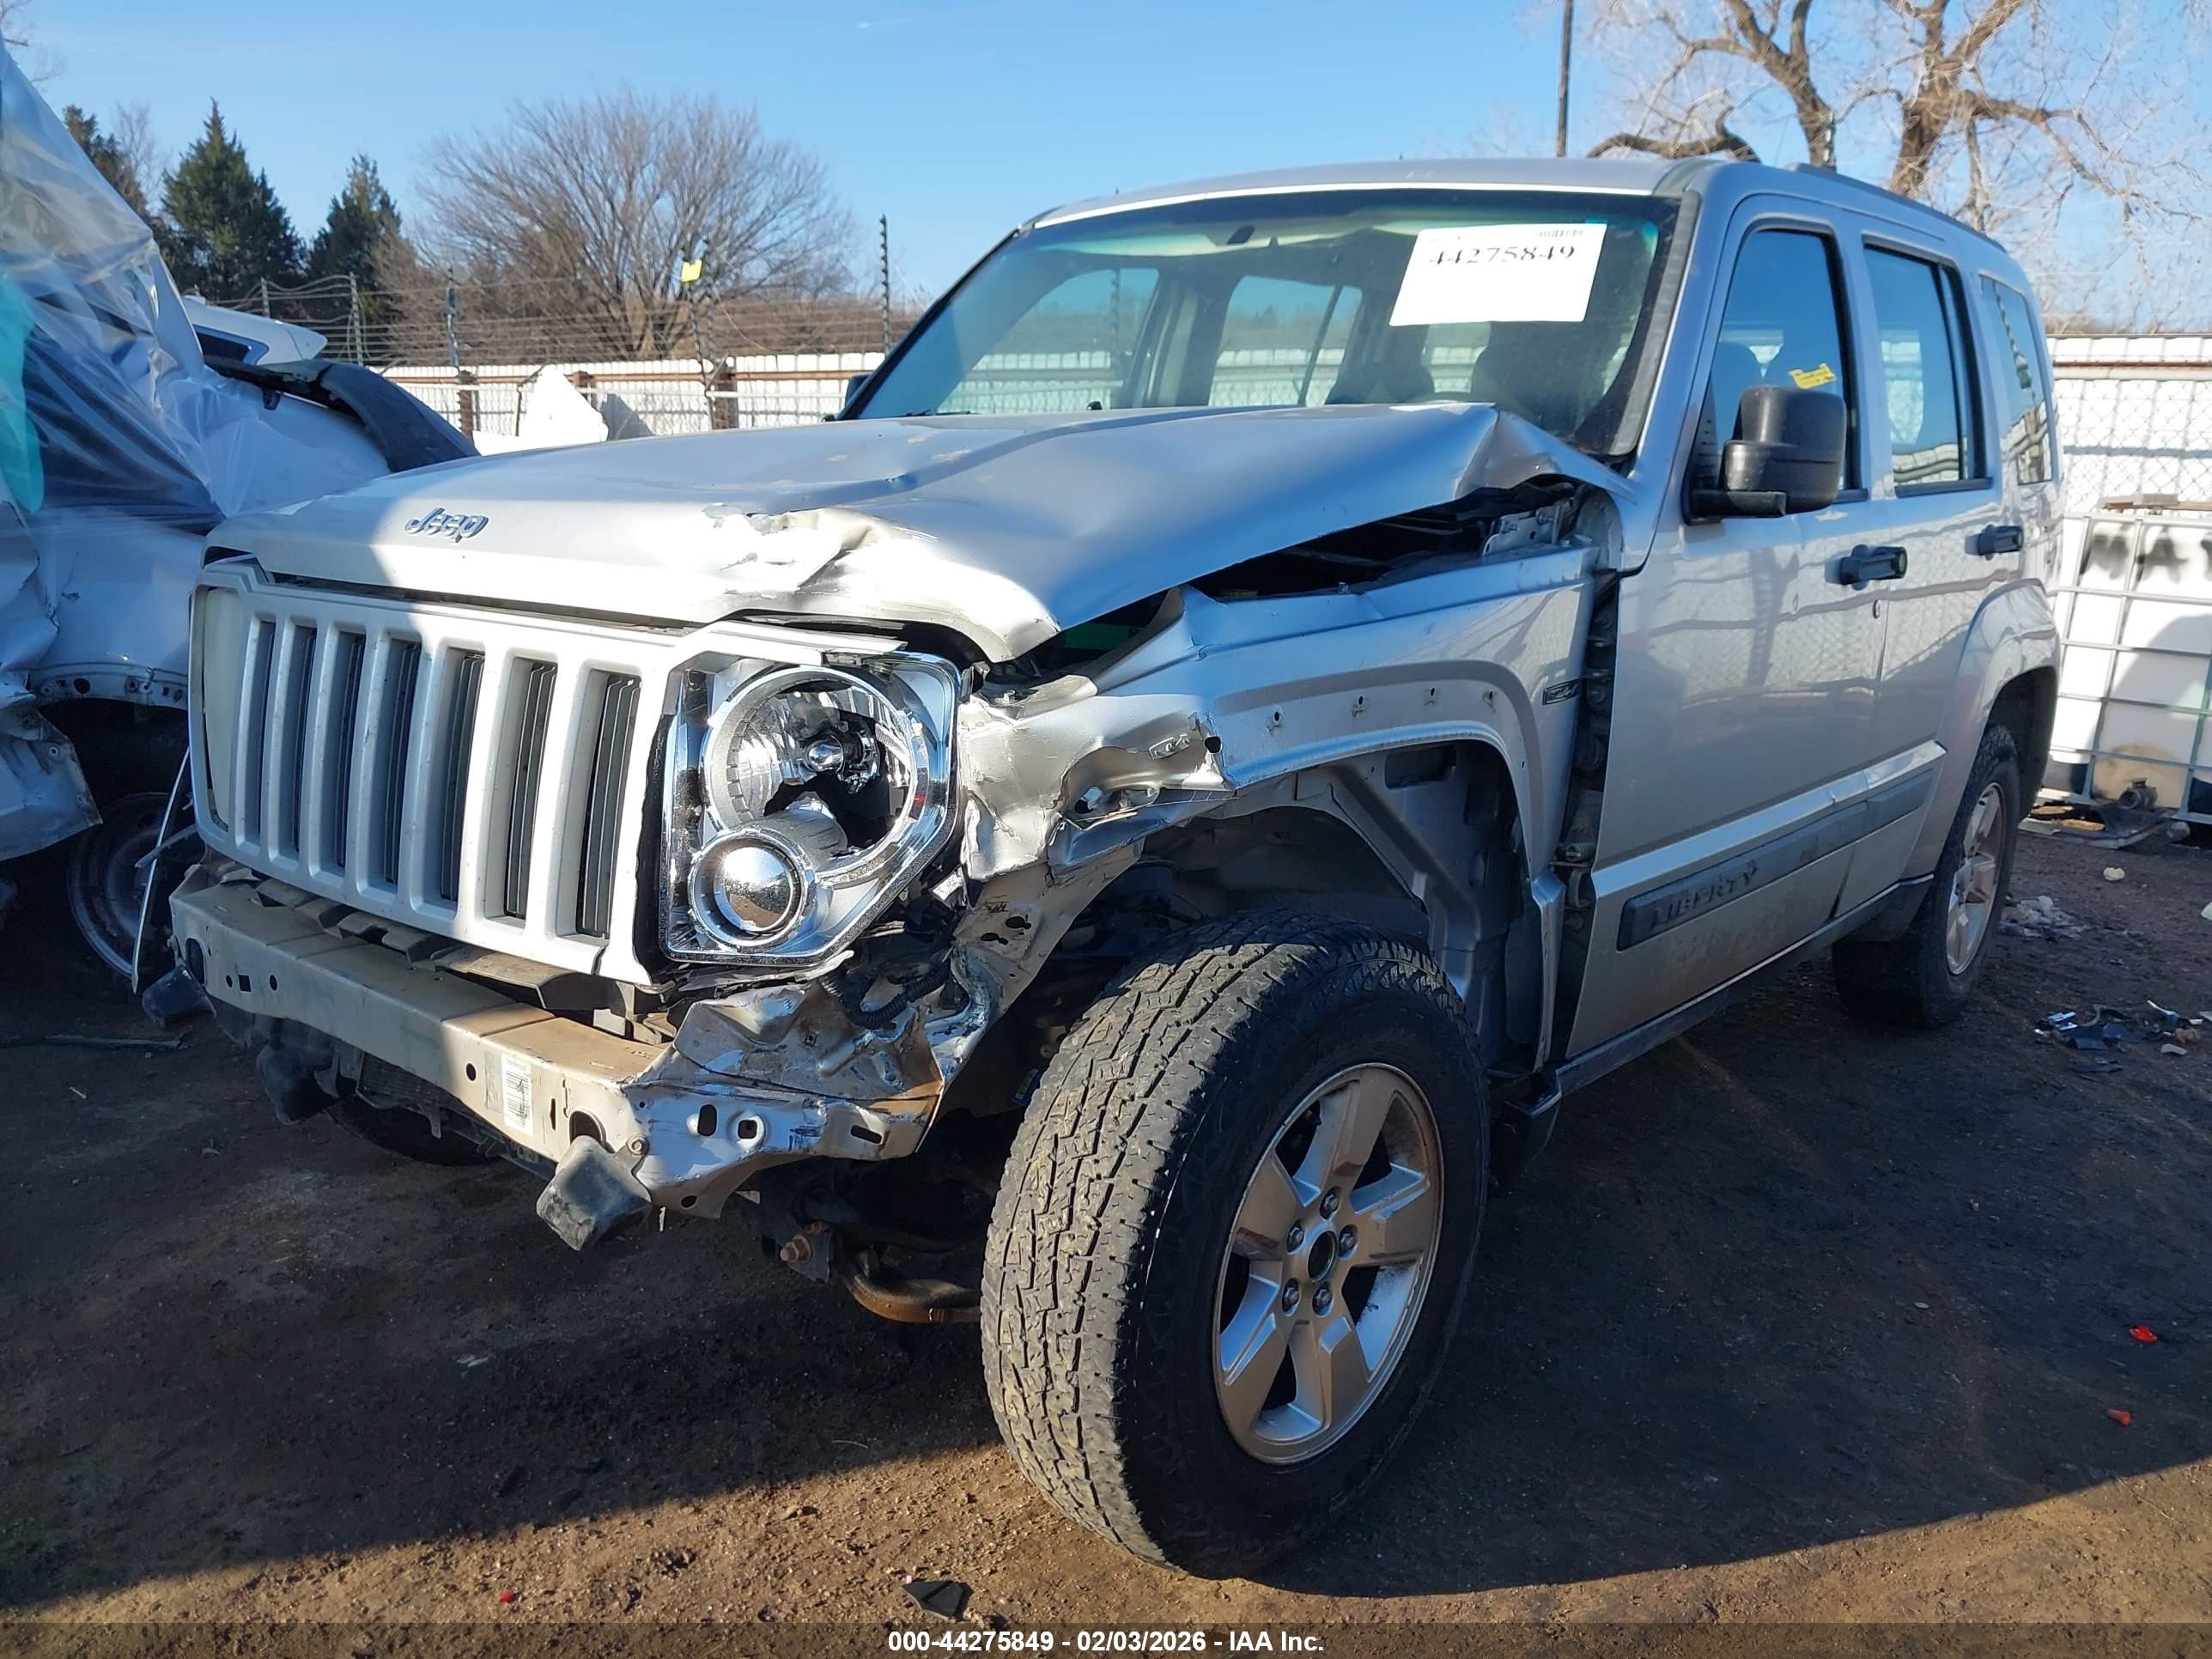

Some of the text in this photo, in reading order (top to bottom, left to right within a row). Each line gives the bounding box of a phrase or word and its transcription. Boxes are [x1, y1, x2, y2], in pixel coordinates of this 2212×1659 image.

[1429, 245, 1575, 264] 44275849
[404, 507, 489, 543] Jeep
[1649, 860, 1759, 928] LIBERTY
